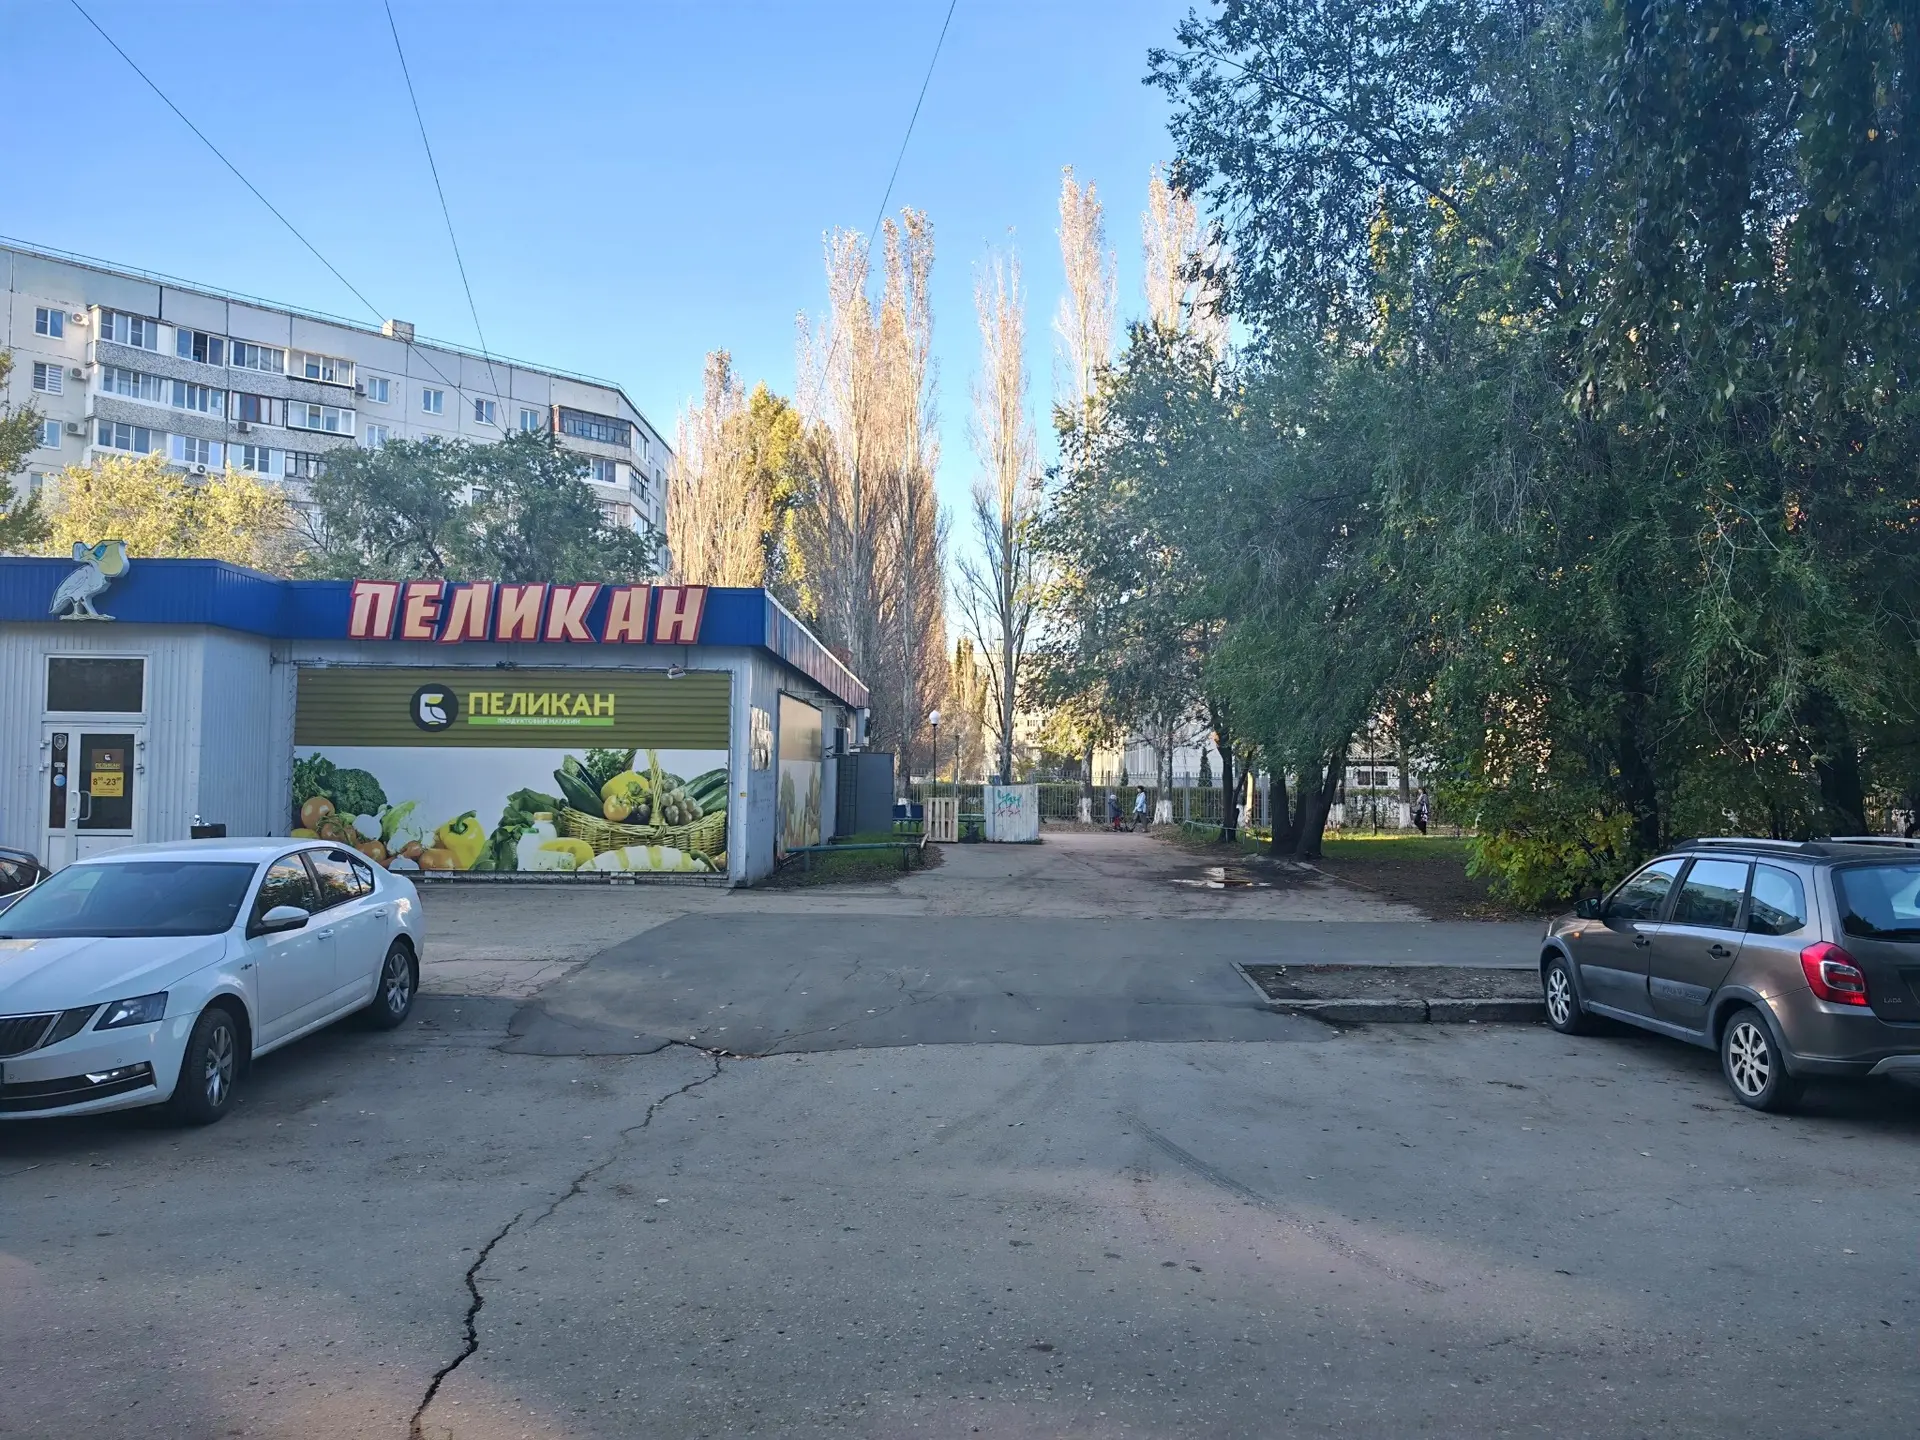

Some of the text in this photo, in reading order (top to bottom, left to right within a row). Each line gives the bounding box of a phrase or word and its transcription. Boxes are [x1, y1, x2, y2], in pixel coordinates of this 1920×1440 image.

[348, 580, 708, 645] ПЕЛИКАН
[468, 692, 615, 716] ПЕЛИКАН
[497, 717, 548, 725] ПРОДУКТОВЫЙ
